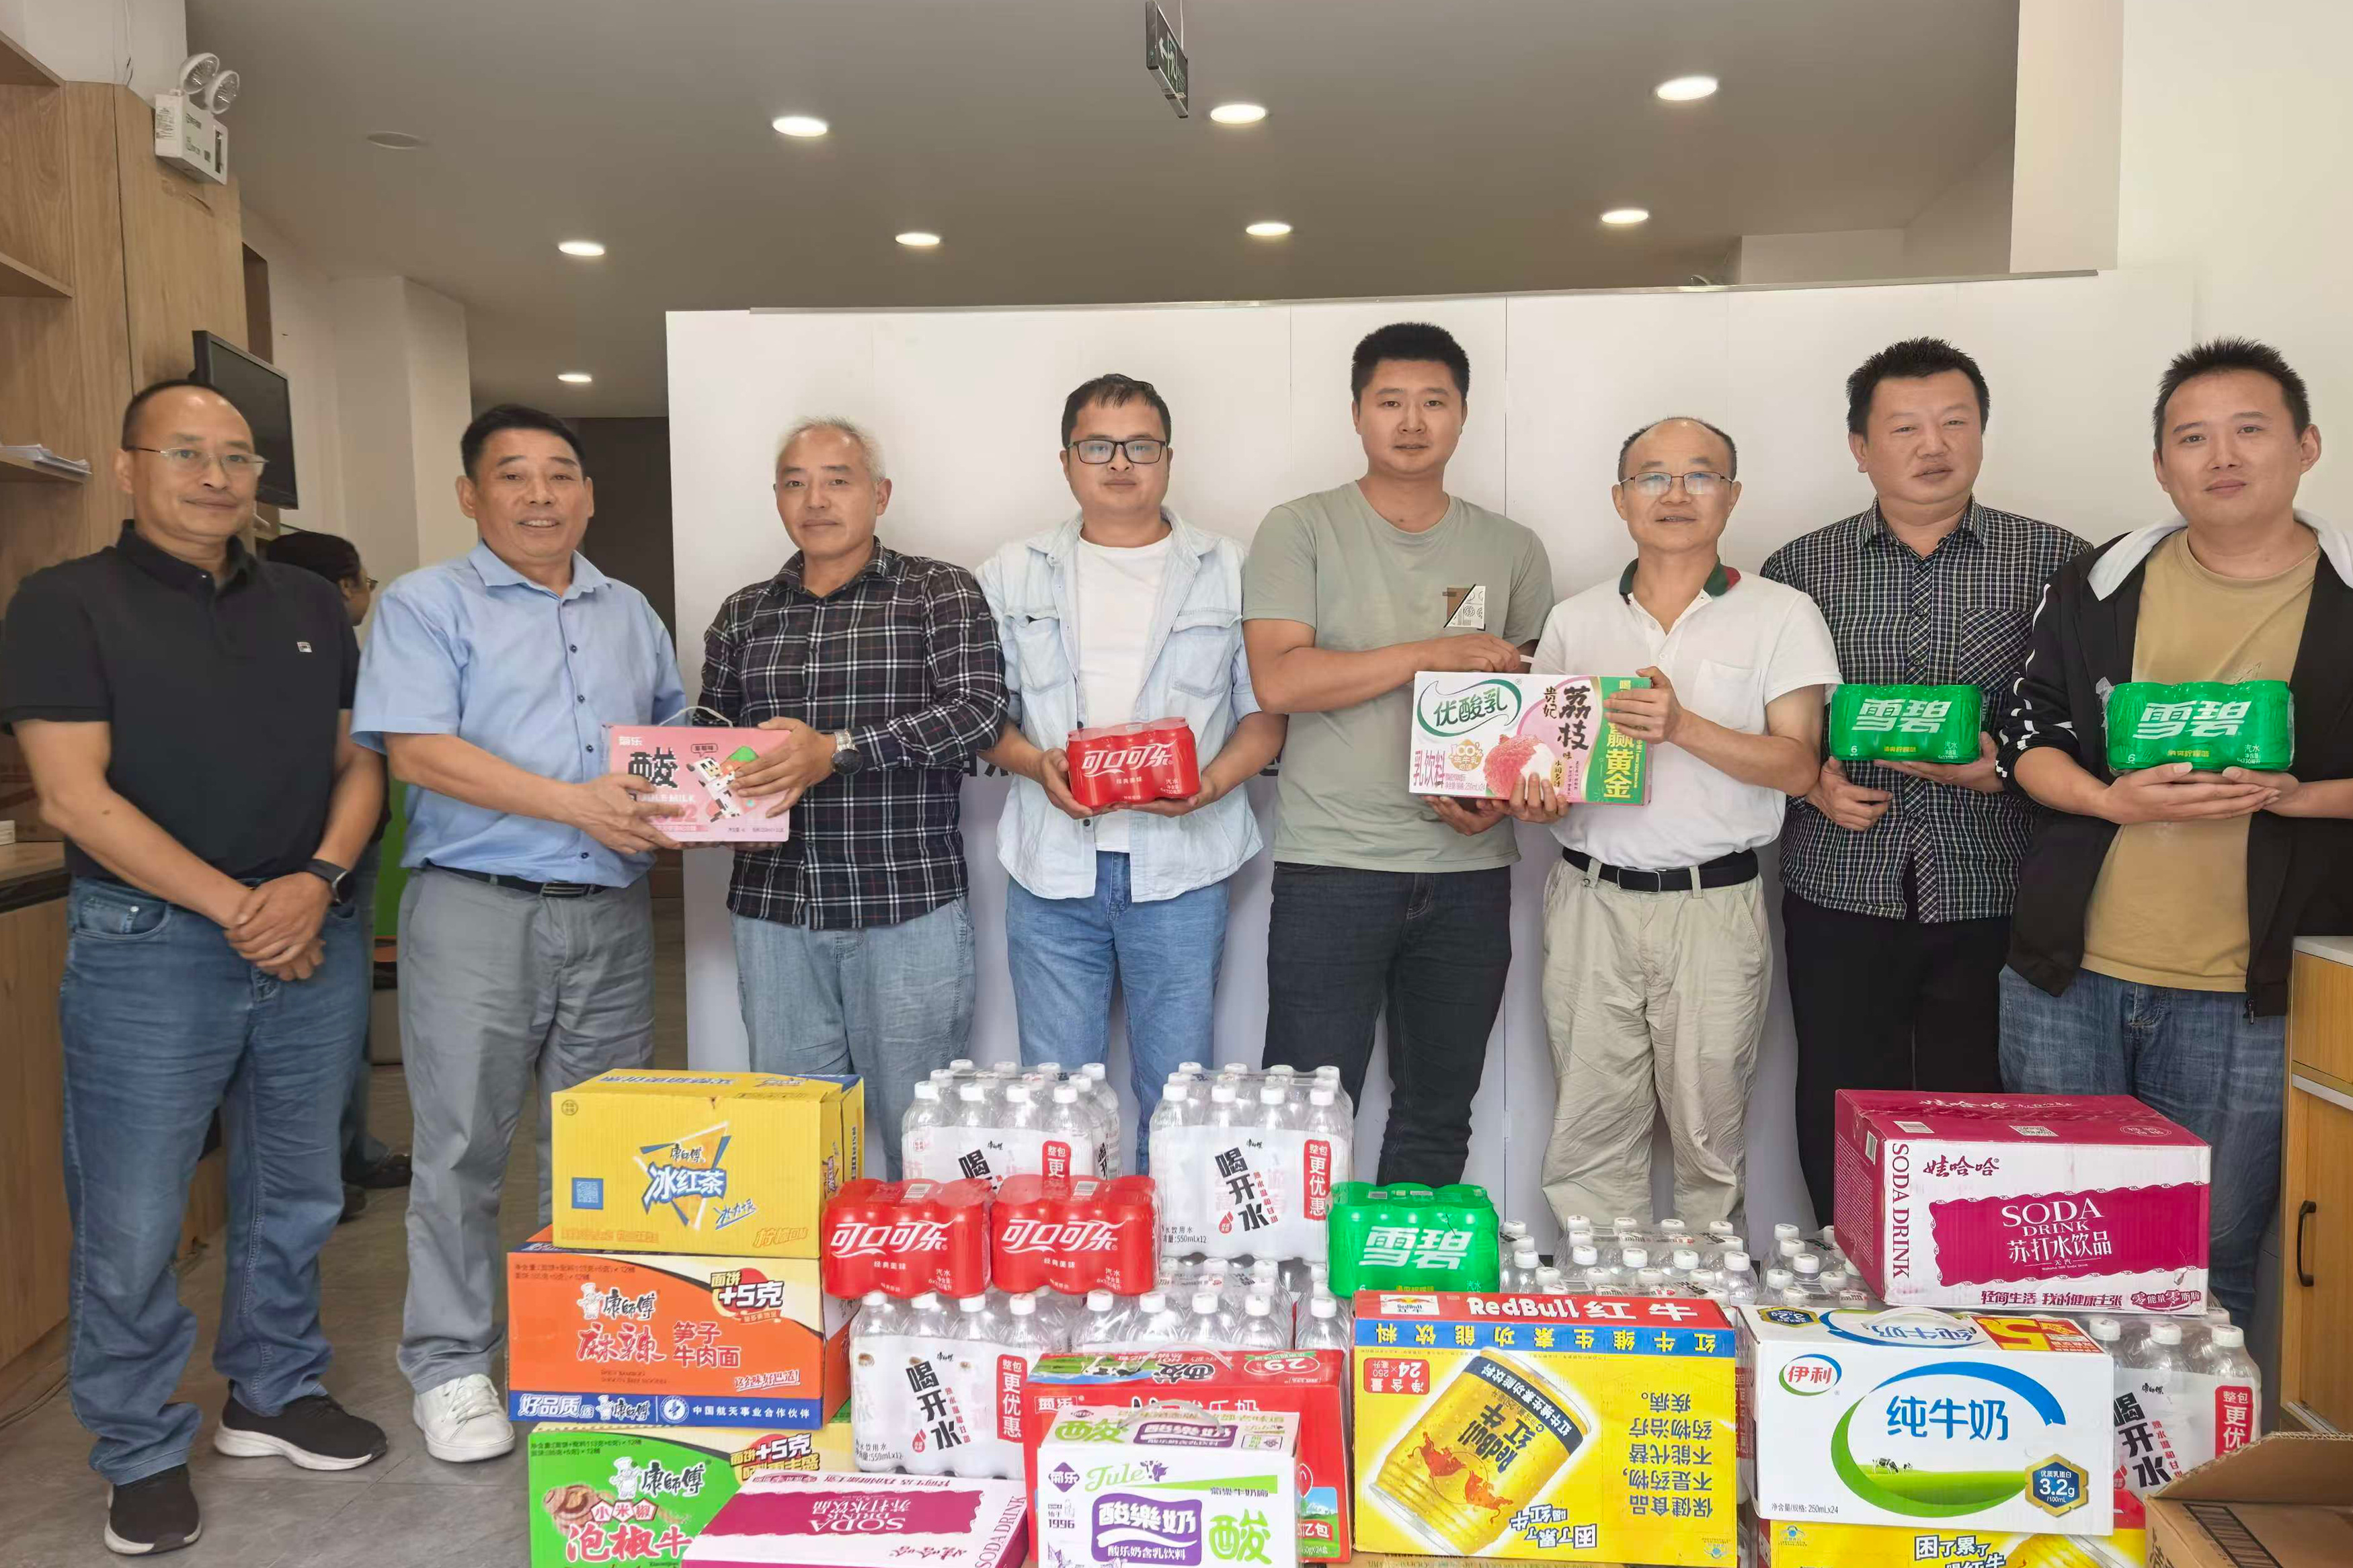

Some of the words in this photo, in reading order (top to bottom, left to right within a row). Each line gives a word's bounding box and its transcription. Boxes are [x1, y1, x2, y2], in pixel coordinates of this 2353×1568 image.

[1433, 687, 1508, 727] 优酸乳
[1557, 686, 1591, 751] 荔枝
[1852, 698, 1951, 733] 雪碧
[2132, 700, 2250, 738] 雪碧
[1081, 739, 1176, 777] 可口可乐
[1851, 745, 1858, 753] 6
[2128, 754, 2136, 762] 6
[2245, 744, 2260, 752] 汽水
[1047, 1145, 1066, 1157] 整包
[1309, 1144, 1328, 1156] 整包
[1892, 1145, 1909, 1202] SODA
[1923, 1155, 1995, 1177] 娃哈哈
[643, 1163, 725, 1210] 冰红茶
[1215, 1147, 1269, 1231] 喝开水
[1309, 1157, 1326, 1216] 更优惠
[2001, 1198, 2104, 1227] SODA
[830, 1219, 955, 1258] 可口可乐
[1001, 1219, 1127, 1254] 可口可乐
[2022, 1220, 2088, 1237] DRINK
[1359, 1226, 1471, 1270] 雪碧
[1893, 1210, 1909, 1278] DRINK
[2007, 1231, 2112, 1264] 苏打水饮品
[711, 1271, 741, 1287] 面饼
[719, 1281, 784, 1307] +5克
[1467, 1297, 1580, 1319] RedBull
[1584, 1302, 1698, 1322] 红牛
[577, 1322, 666, 1363] 麻辣
[674, 1321, 721, 1345] 笋子
[1376, 1323, 1717, 1352] 红牛维生素功能饮料
[672, 1346, 740, 1368] 牛肉面
[1002, 1358, 1022, 1372] 整包
[1371, 1378, 1424, 1393] 净含量
[1788, 1365, 1832, 1384] 伊利
[906, 1360, 962, 1450] 喝开水
[1003, 1373, 1022, 1438] 更优惠
[1481, 1364, 1572, 1436] 红牛维生素功能饮料
[2223, 1391, 2248, 1404] 整包
[692, 1405, 810, 1419] 中国航天事业合作伙伴
[1886, 1395, 2008, 1441] 纯牛奶
[1480, 1404, 1536, 1450] 红牛
[1629, 1419, 1712, 1438] 药物治疗
[2223, 1405, 2247, 1450] 更优
[756, 1434, 811, 1460] +5克
[1458, 1420, 1518, 1474] RedBull
[1630, 1446, 1712, 1466] 不能代替
[1085, 1463, 1143, 1493] Jule
[2040, 1478, 2075, 1497] 3.2g
[593, 1501, 656, 1522] 小米椒
[994, 1496, 1027, 1532] DRINK
[1509, 1504, 1568, 1531] 喝红牛
[1631, 1495, 1713, 1518] 保健食品
[809, 1518, 906, 1532] SODA
[1048, 1520, 1075, 1528] 1996
[1209, 1509, 1272, 1565] 酸
[1525, 1524, 1597, 1549] 困了累了
[567, 1524, 692, 1563] 泡椒牛
[1915, 1535, 1991, 1561] 困了累了
